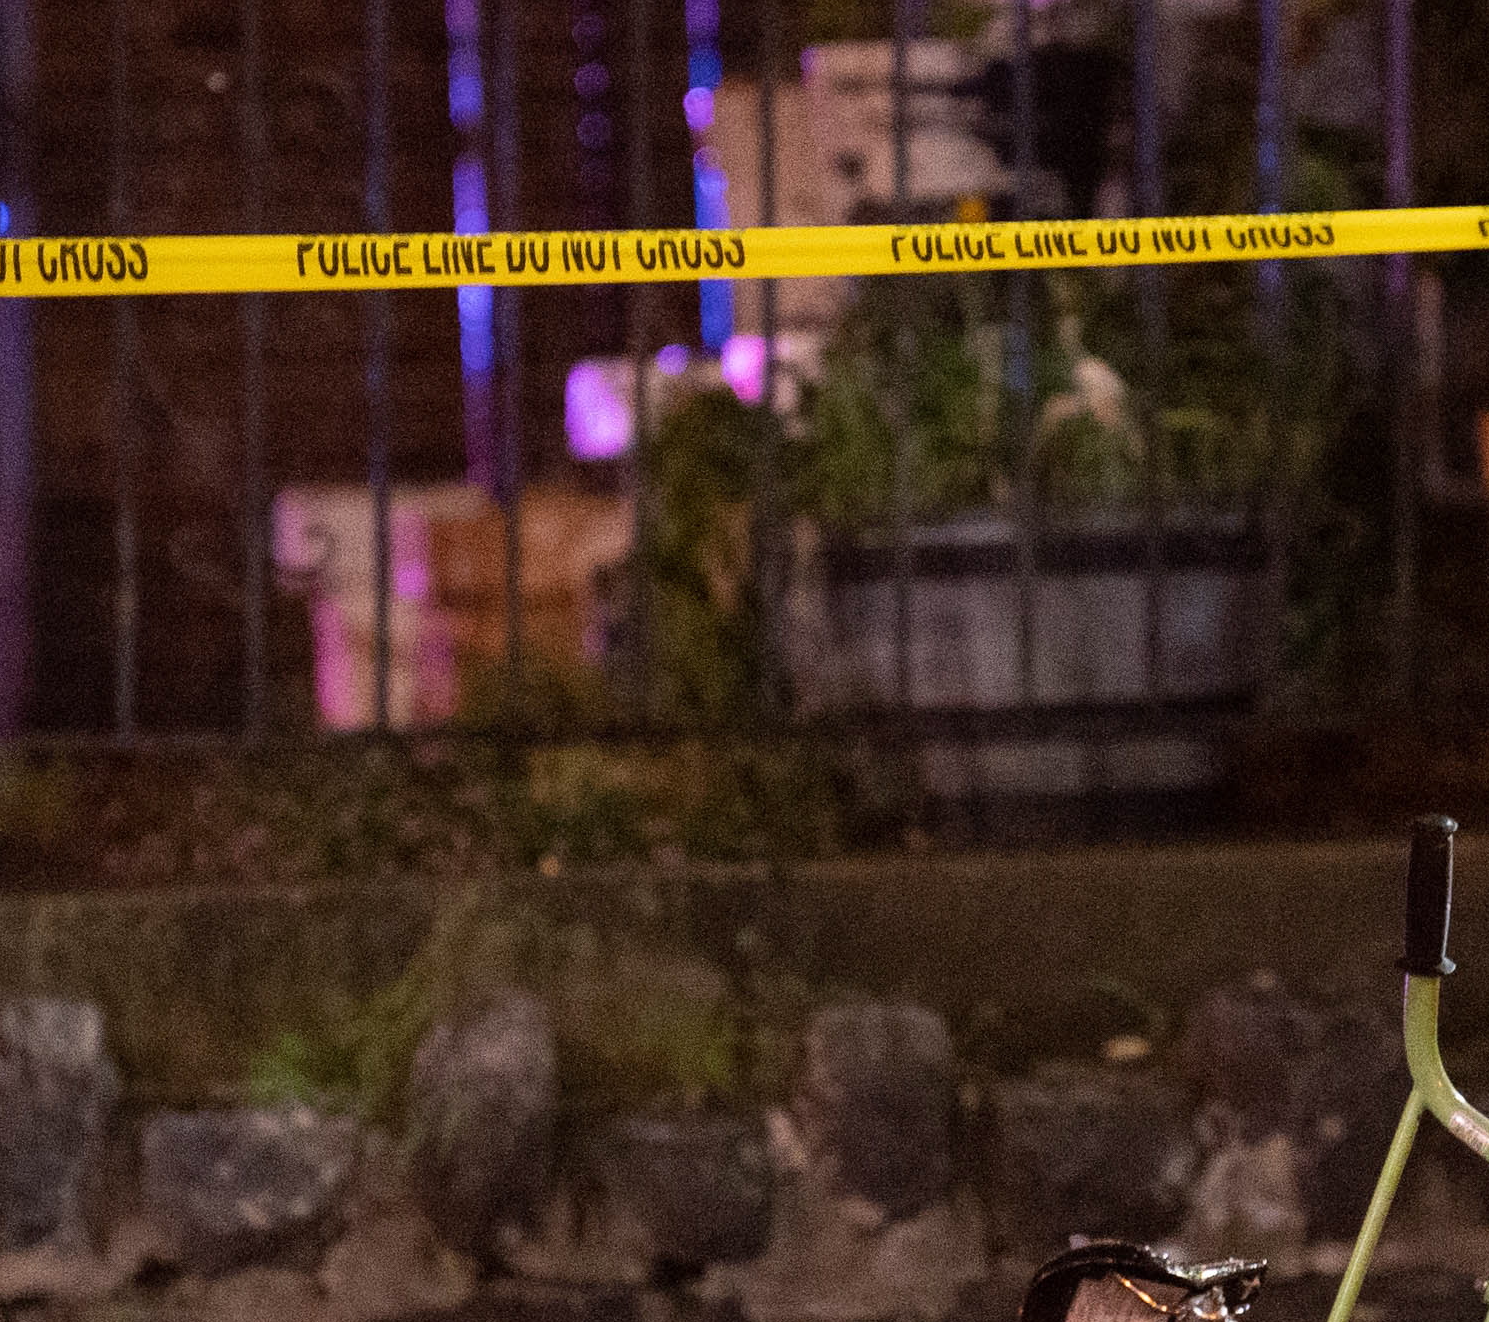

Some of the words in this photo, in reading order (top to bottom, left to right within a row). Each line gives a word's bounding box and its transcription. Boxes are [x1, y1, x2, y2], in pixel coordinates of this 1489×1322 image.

[37, 243, 149, 281] CROSS
[296, 241, 413, 278] POLICE
[422, 241, 496, 275] LINE
[509, 241, 550, 274] DO
[562, 240, 624, 272] NOT
[635, 238, 746, 271] CROSS
